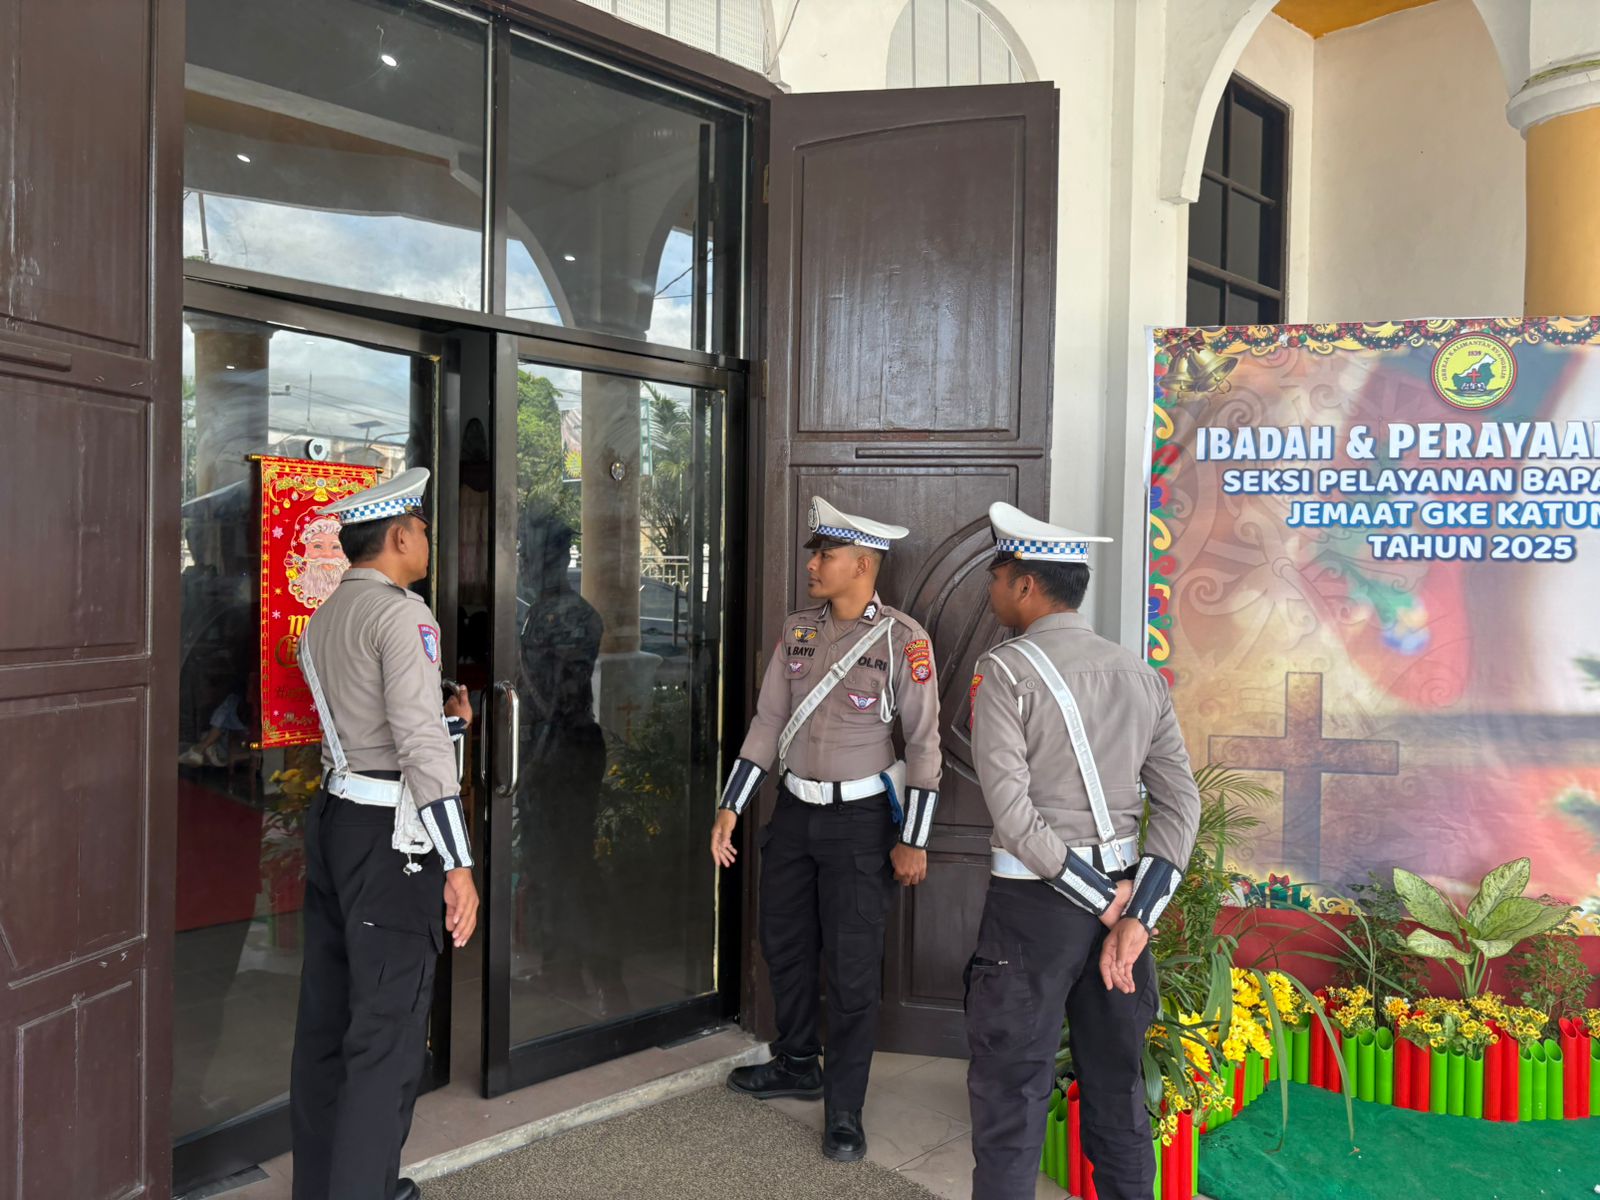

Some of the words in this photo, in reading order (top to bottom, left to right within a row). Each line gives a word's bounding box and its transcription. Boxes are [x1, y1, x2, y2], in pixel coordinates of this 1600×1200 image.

[1448, 341, 1492, 356] KALIMANTAN
[1195, 425, 1334, 461] IBADAH
[1346, 424, 1377, 460] &
[1222, 468, 1312, 493] SEKSI
[1318, 467, 1515, 493] PELAYANAN
[1286, 501, 1415, 526] JEMAAT
[1421, 501, 1489, 526] GKE
[1367, 535, 1483, 559] TAHUN
[1490, 535, 1573, 560] 2025
[857, 656, 888, 671] OLRI
